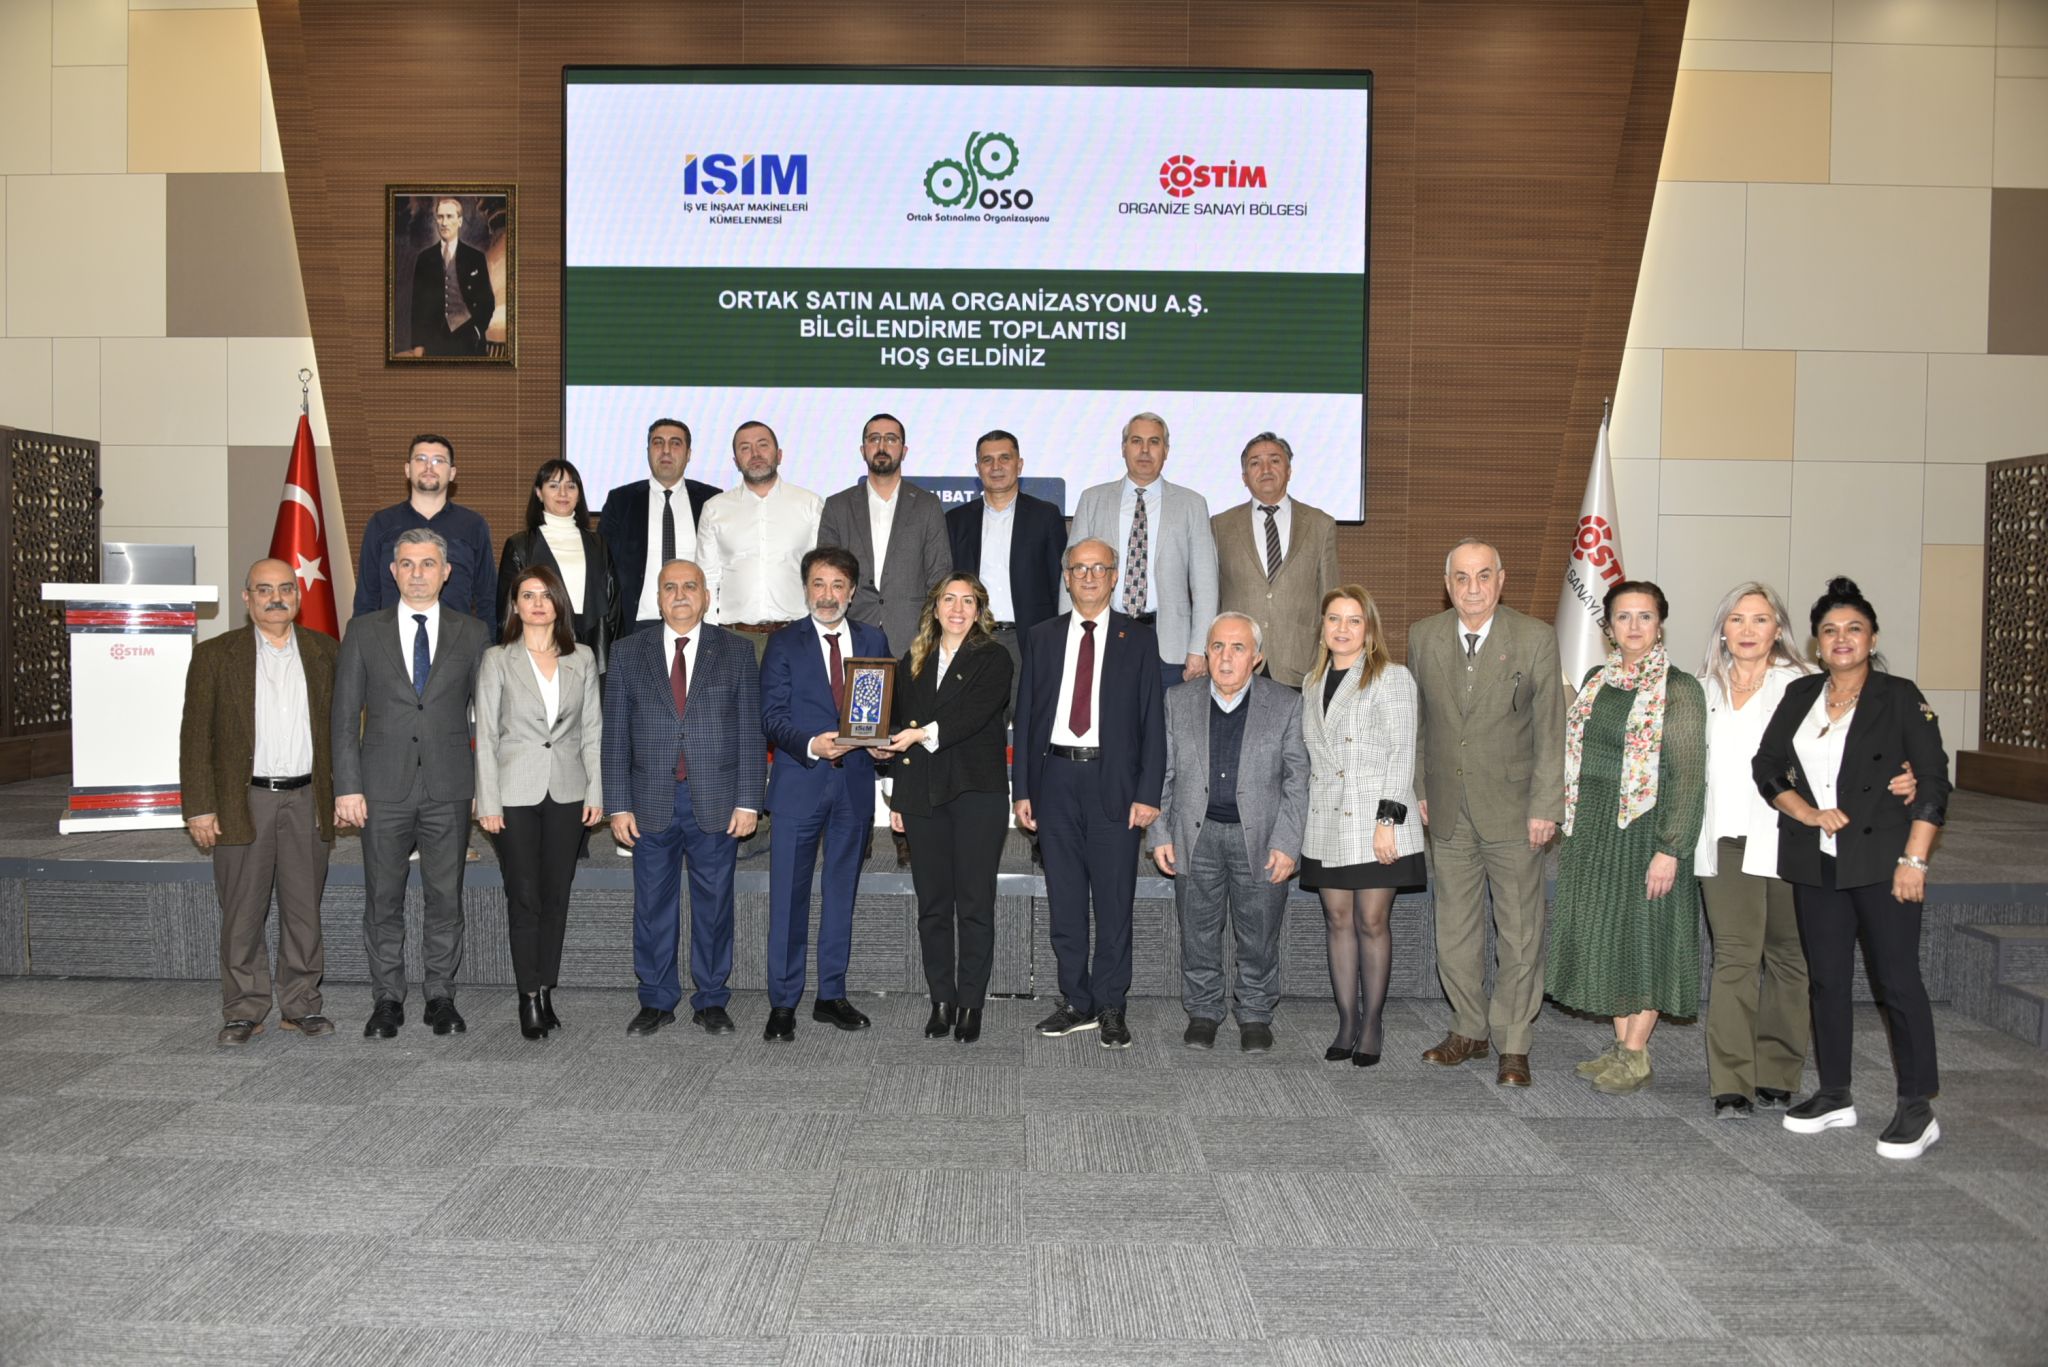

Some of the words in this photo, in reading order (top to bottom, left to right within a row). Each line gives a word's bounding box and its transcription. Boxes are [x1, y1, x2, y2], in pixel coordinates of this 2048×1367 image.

[1168, 159, 1268, 188] OSTİM
[683, 201, 693, 213] İŞ
[695, 202, 708, 211] VE
[710, 201, 746, 213] İNŞAAT
[747, 201, 808, 212] MAKİNELERİ
[979, 188, 1034, 210] OSO
[1118, 200, 1190, 215] ORGANİZE
[1193, 201, 1245, 216] SANAYİ
[1250, 202, 1308, 217] BÖLGESİ
[709, 214, 782, 225] KÜMELENMESİ
[906, 212, 933, 222] Ortak
[935, 213, 981, 222] Satınalma
[983, 213, 1050, 224] Organizasyonu
[718, 290, 799, 310] ORTAK
[806, 291, 873, 311] SATIN
[879, 292, 945, 311] ALMA
[951, 288, 1157, 313] ORGANİZASYONU
[1164, 294, 1209, 317] A.Ş.
[800, 314, 982, 339] BİLGİLENDİRME
[989, 320, 1127, 341] TOPLANTISI
[881, 346, 930, 370] HOŞ
[937, 343, 1046, 367] GELDİNİZ
